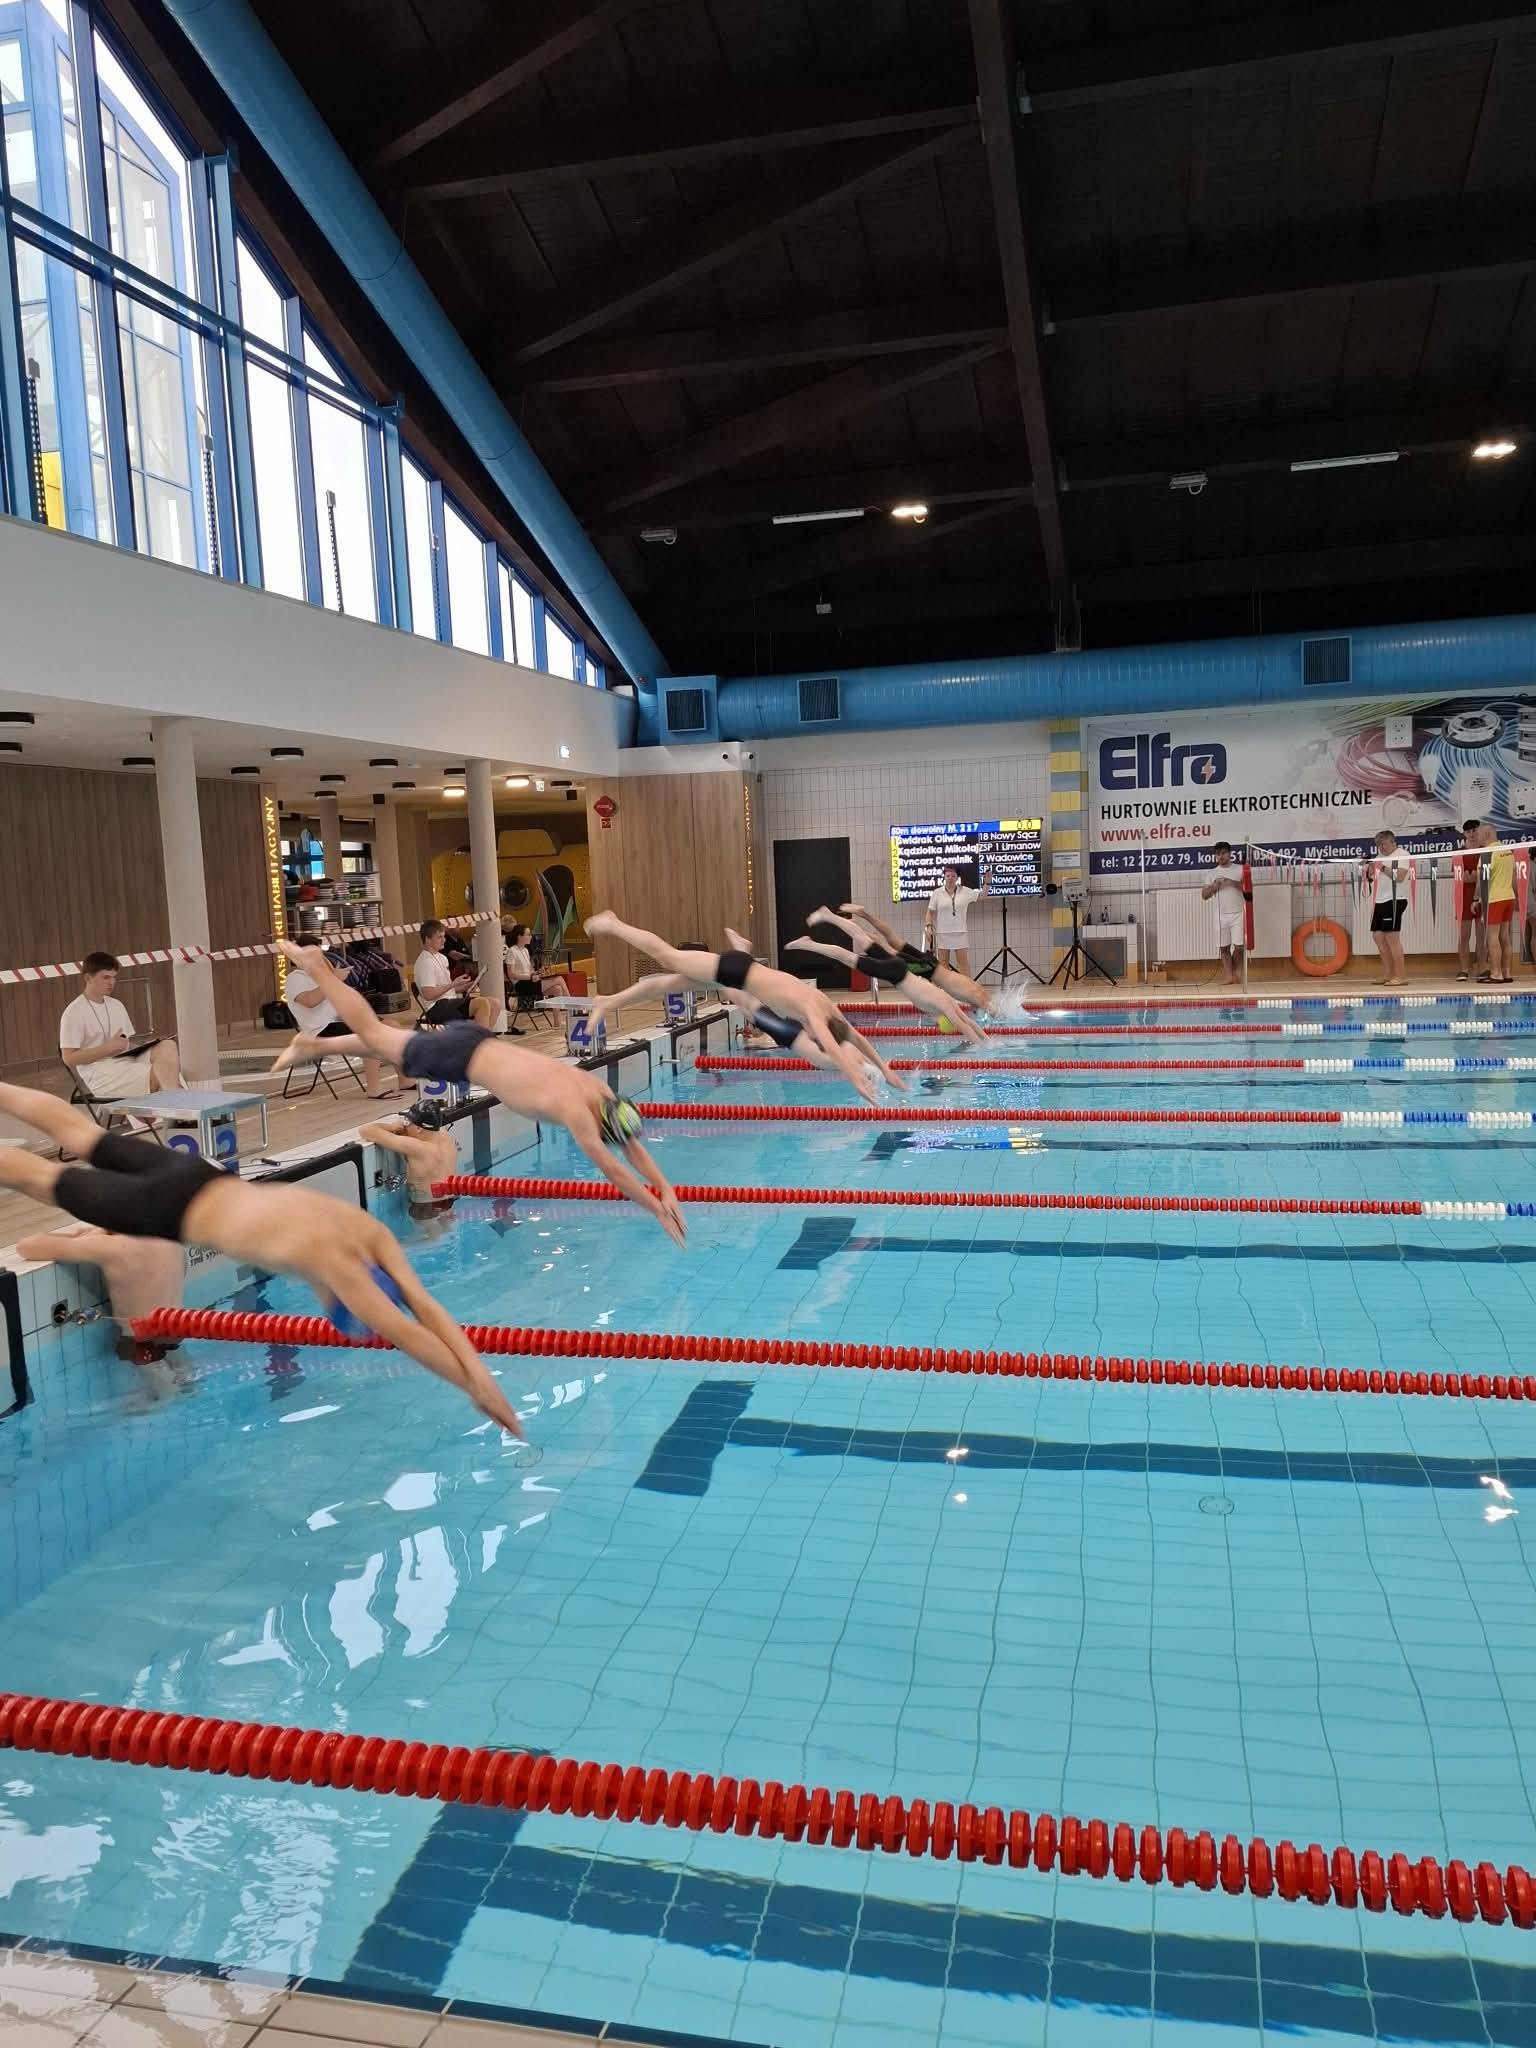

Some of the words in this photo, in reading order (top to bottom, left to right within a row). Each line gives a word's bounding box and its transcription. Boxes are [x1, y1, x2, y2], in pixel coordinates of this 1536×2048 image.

[1099, 732, 1227, 790] Elfra
[1101, 800, 1197, 820] HURTOWNIE
[1203, 789, 1372, 814] ELEKTROTECHNICZNE
[911, 824, 945, 835] dowolny
[991, 832, 1015, 841] Nowy
[1017, 831, 1038, 839] Sącz
[1101, 823, 1211, 842] www.elfra.eu
[935, 856, 973, 865] Dominik
[986, 853, 1034, 862] Wadowice
[1101, 856, 1119, 868] tel:
[1122, 856, 1135, 867] 12
[1161, 854, 1174, 865] 02
[1178, 853, 1194, 865] 79,
[1305, 844, 1366, 860] Myślenice,
[995, 864, 1036, 872] Chocznia
[992, 876, 1016, 885] Nowy
[1018, 875, 1038, 883] Targ
[667, 993, 686, 1015] 5
[570, 1019, 593, 1047] 4
